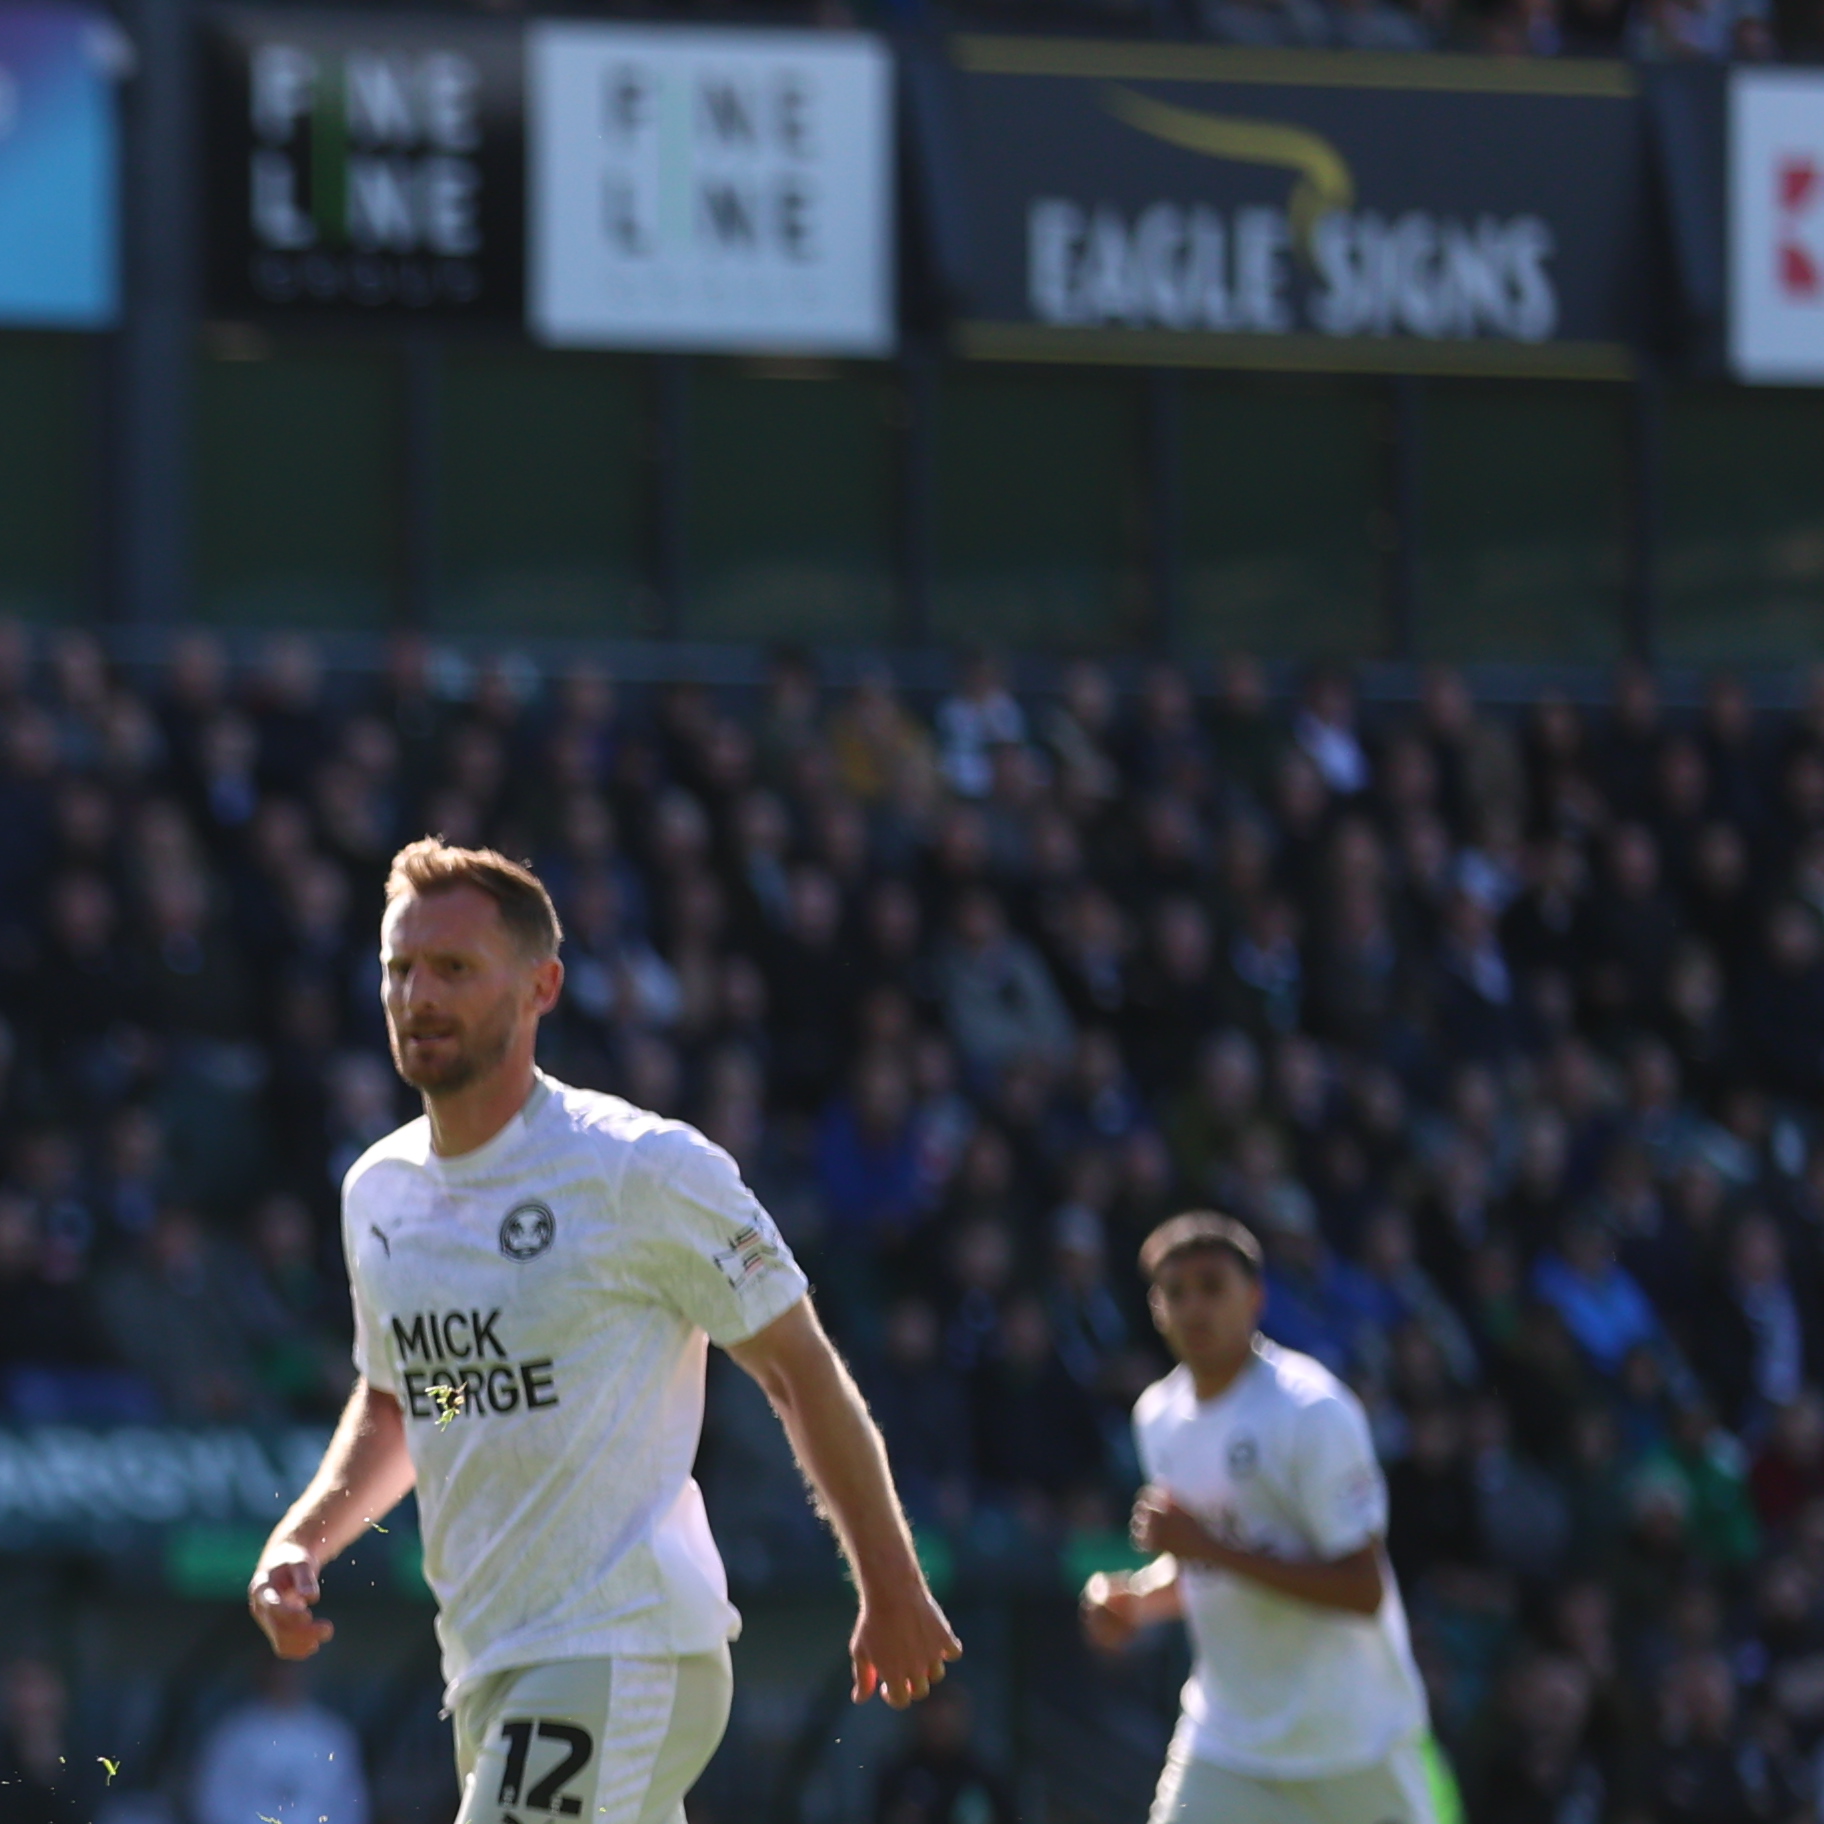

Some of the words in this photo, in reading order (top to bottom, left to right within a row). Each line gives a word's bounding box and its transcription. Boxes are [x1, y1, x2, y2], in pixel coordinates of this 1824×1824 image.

[252, 46, 480, 150] FINE
[602, 62, 814, 158] FINE
[252, 151, 480, 253] LINE
[602, 166, 816, 262] LINE
[1028, 202, 1292, 331] EAGLE
[1313, 208, 1557, 341] SIGNS
[392, 1308, 507, 1362] MICK
[404, 1358, 559, 1417] EORGE
[498, 1721, 593, 1817] 12
